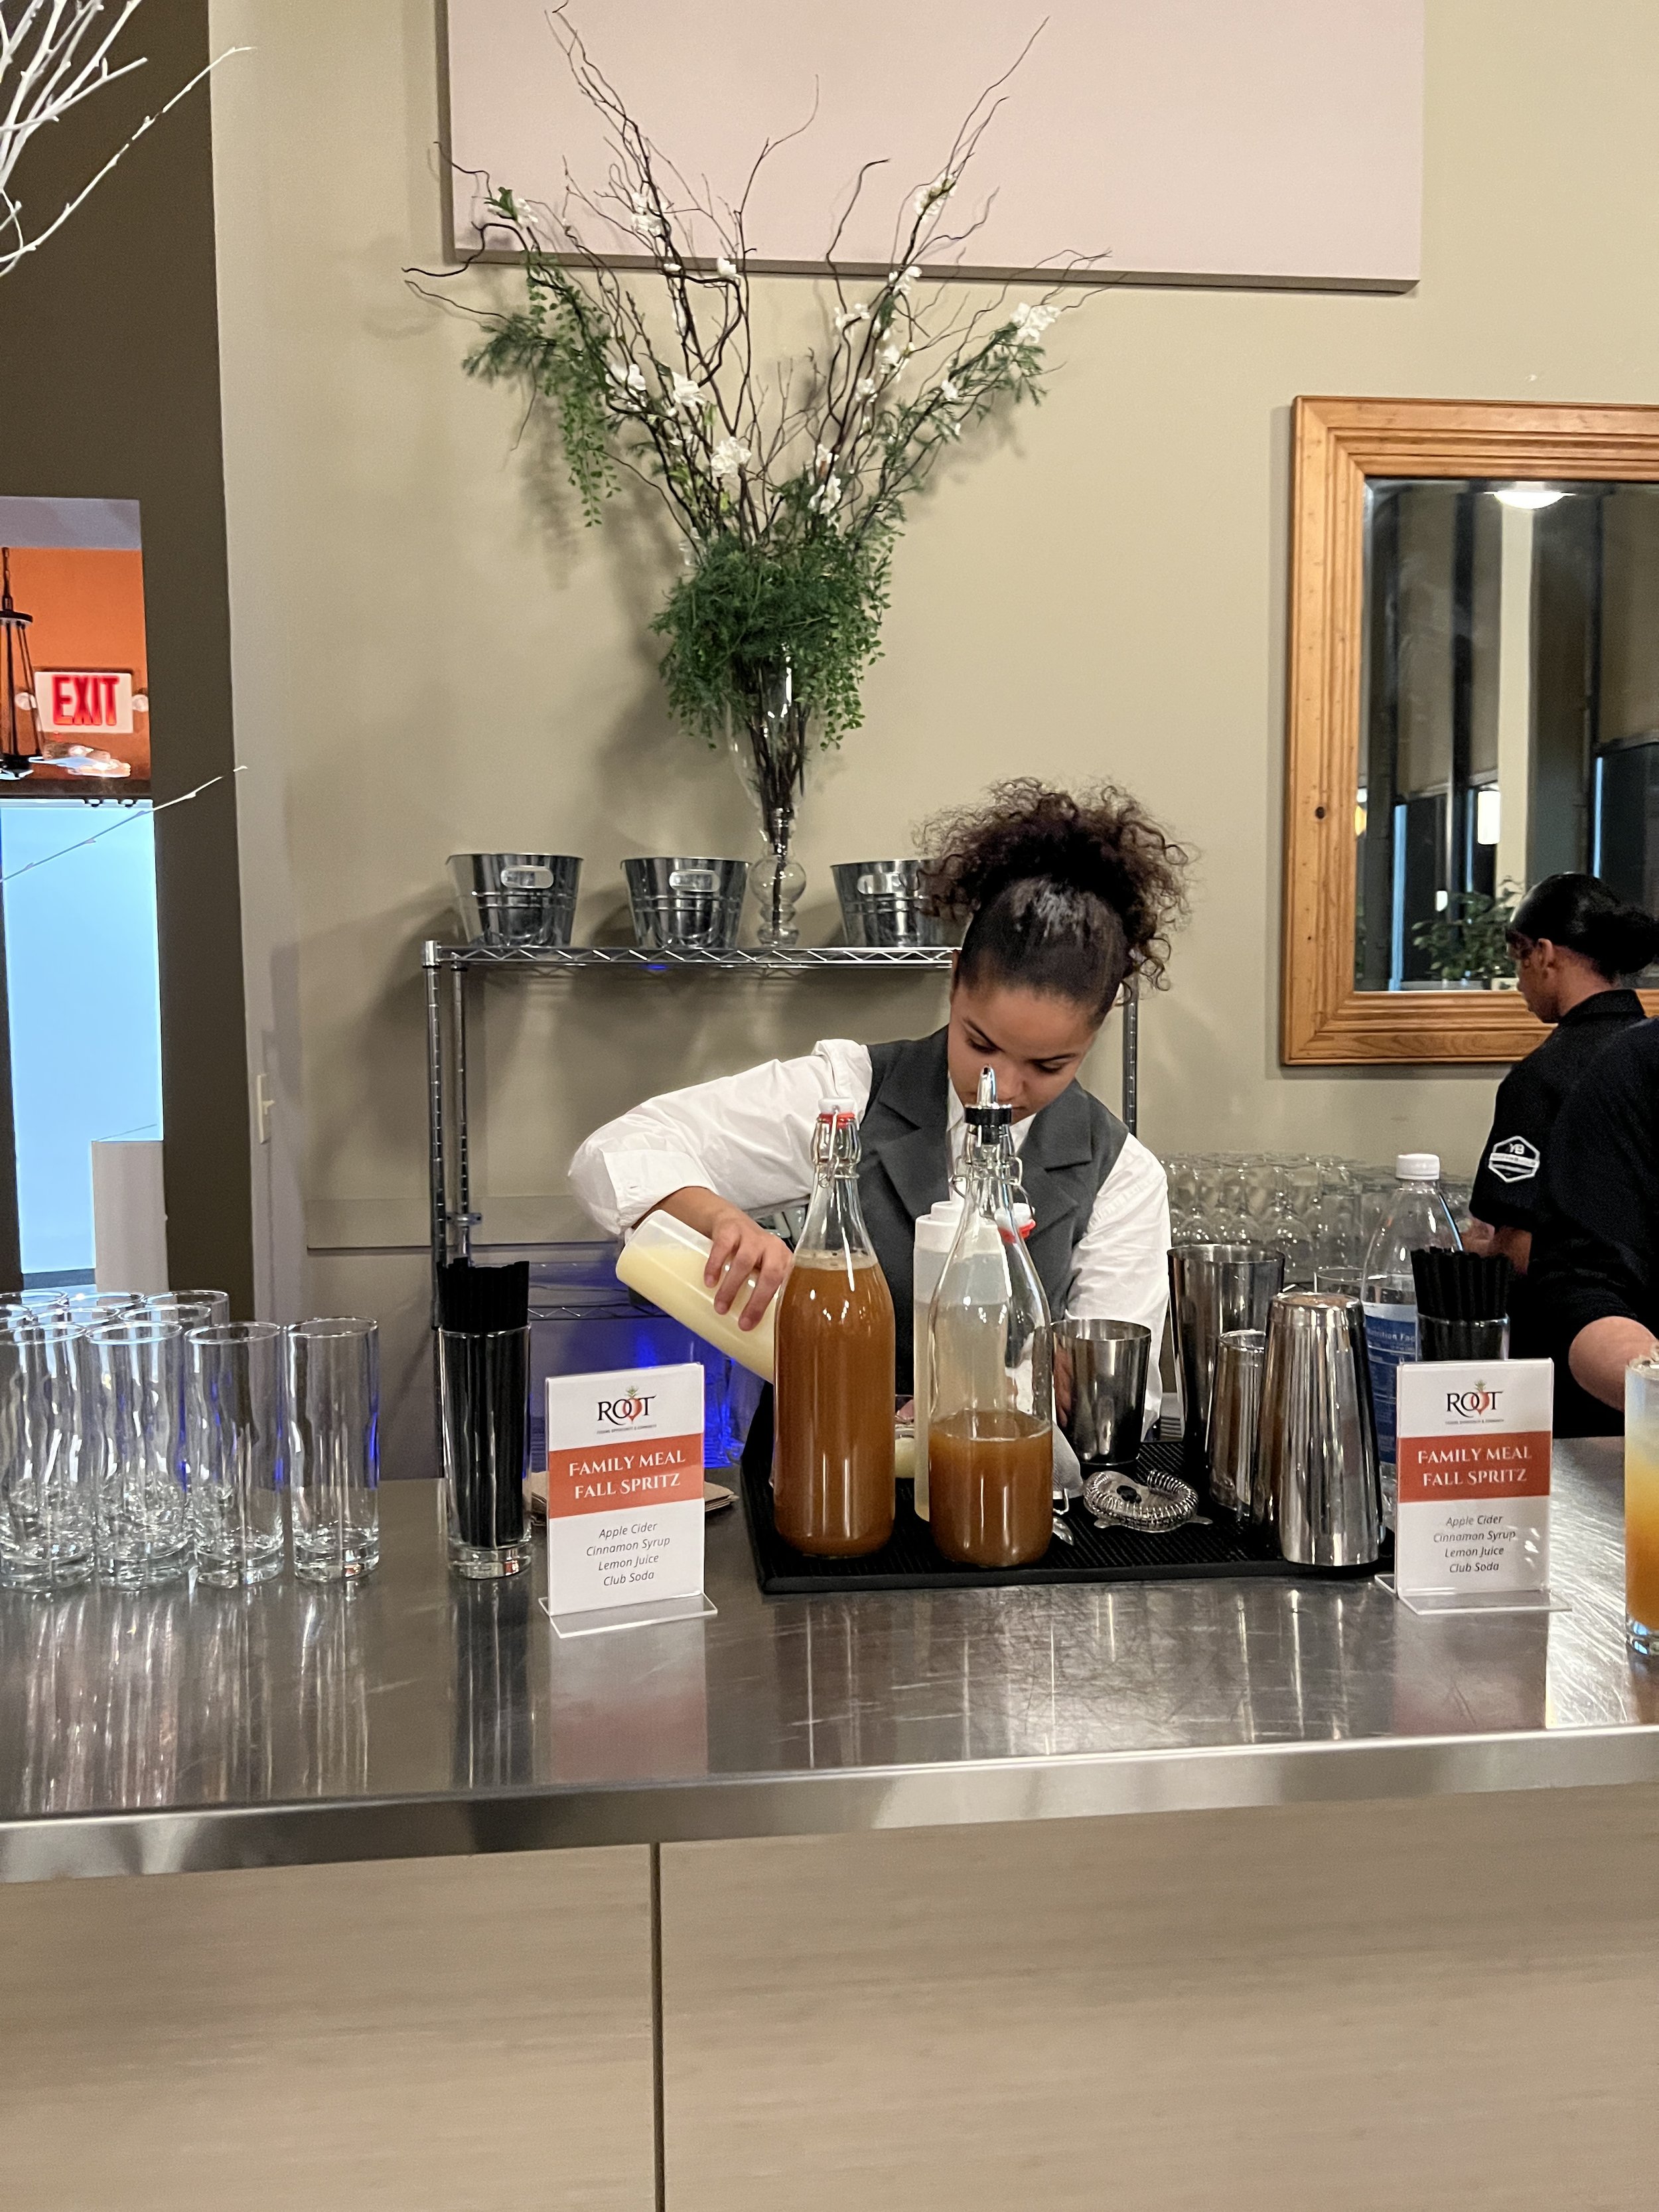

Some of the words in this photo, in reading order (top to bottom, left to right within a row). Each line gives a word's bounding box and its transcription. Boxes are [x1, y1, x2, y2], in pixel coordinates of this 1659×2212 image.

[52, 674, 119, 726] EXIT
[597, 1395, 657, 1426] ROOT
[1447, 1390, 1504, 1418] ROOT
[569, 1455, 634, 1477] FAMILY
[638, 1449, 685, 1468] MEAL
[1417, 1447, 1482, 1464] FAMILY
[1486, 1445, 1532, 1461] MEAL
[575, 1481, 616, 1499] FALL
[620, 1473, 681, 1495] SPRITZ
[1423, 1471, 1463, 1487] FALL
[1467, 1468, 1528, 1485] SPRITZ
[1446, 1516, 1474, 1528] Apple
[1477, 1514, 1504, 1525] Cider
[599, 1526, 628, 1540] Apple
[631, 1522, 658, 1534] Cider
[1433, 1532, 1484, 1543] Cinnamon
[1487, 1530, 1516, 1542] Syrup
[586, 1542, 638, 1556] Cinnamon
[642, 1538, 670, 1550] Syrup
[1445, 1548, 1478, 1558] Lemon
[1479, 1546, 1504, 1558] Juice
[599, 1558, 632, 1571] Lemon
[634, 1554, 659, 1568] Juice
[1449, 1563, 1472, 1573] Club
[1474, 1562, 1500, 1572] Soda
[603, 1574, 626, 1586] Club
[628, 1570, 654, 1583] Soda
